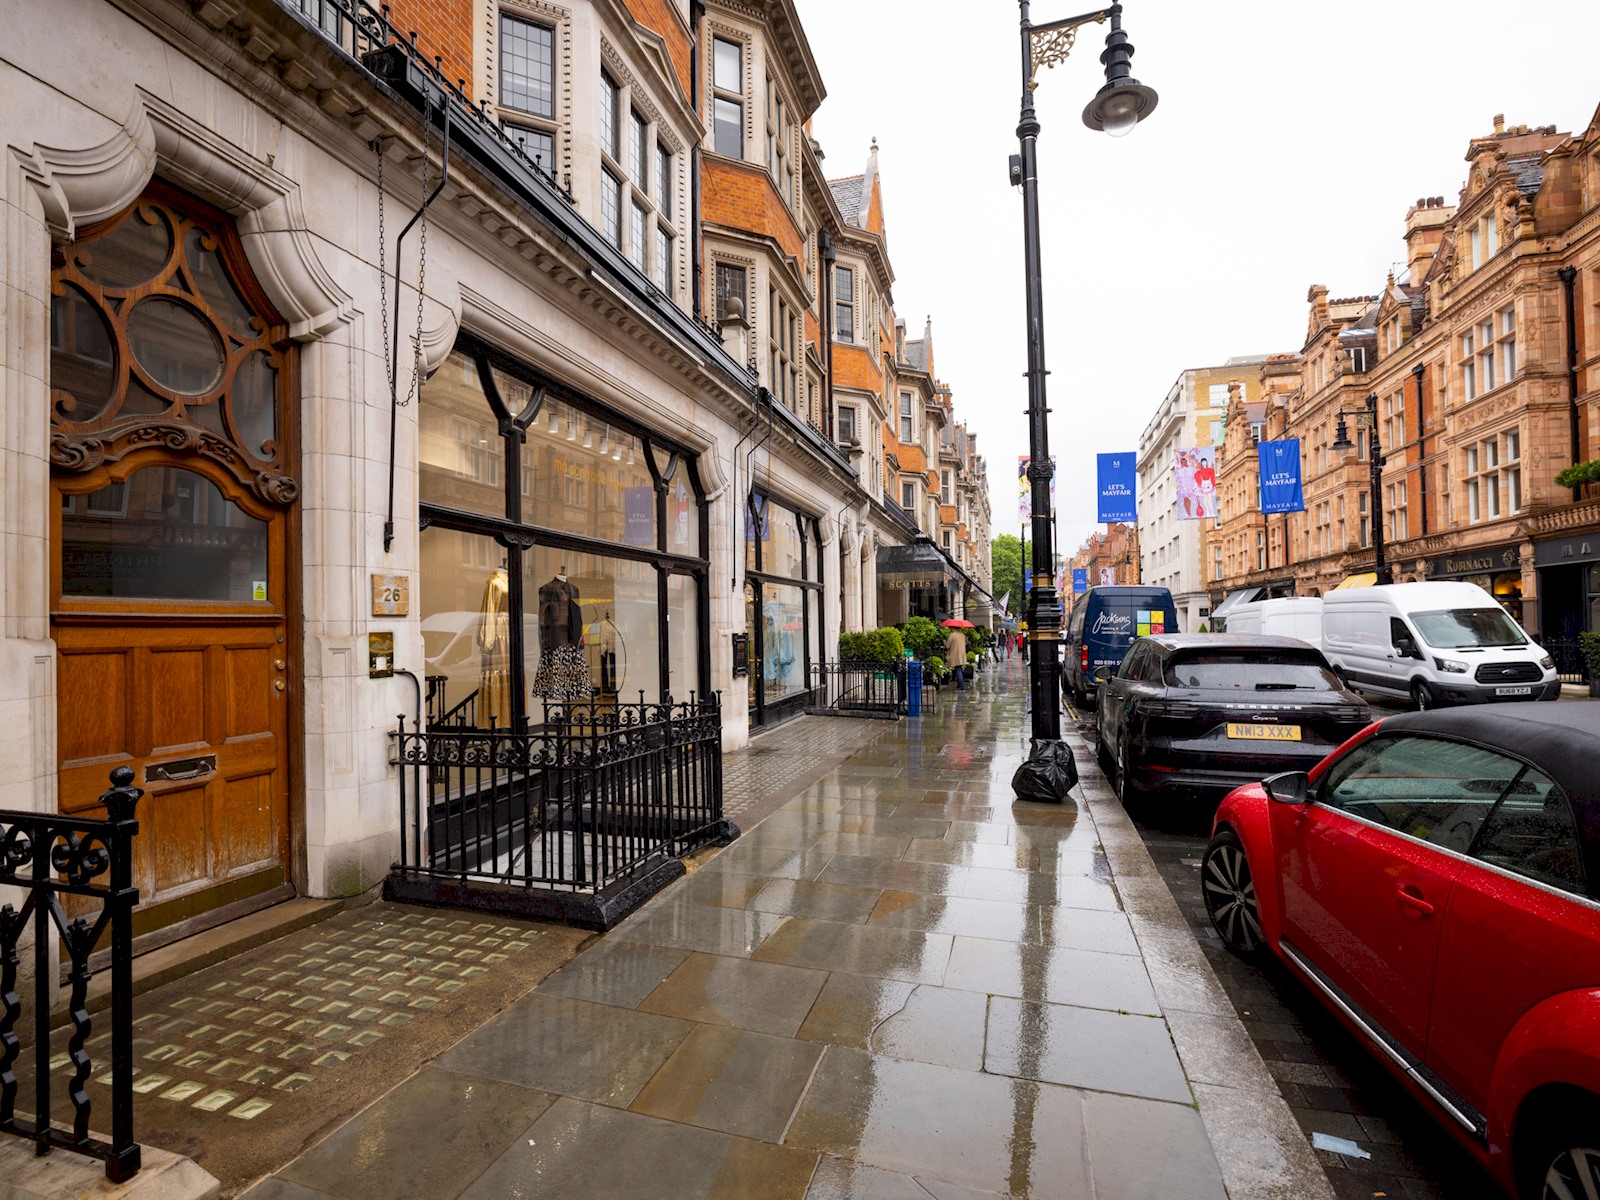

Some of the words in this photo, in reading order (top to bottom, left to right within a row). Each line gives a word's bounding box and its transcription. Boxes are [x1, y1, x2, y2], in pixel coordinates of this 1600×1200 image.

[554, 459, 585, 478] maison
[1271, 471, 1290, 480] LET'S
[1265, 478, 1297, 486] MAYFAIR
[1265, 501, 1299, 509] MAYFAIR
[889, 579, 931, 588] SCOTTS
[384, 588, 401, 602] 26
[1235, 725, 1265, 737] NW13
[1267, 726, 1293, 738] XXX
